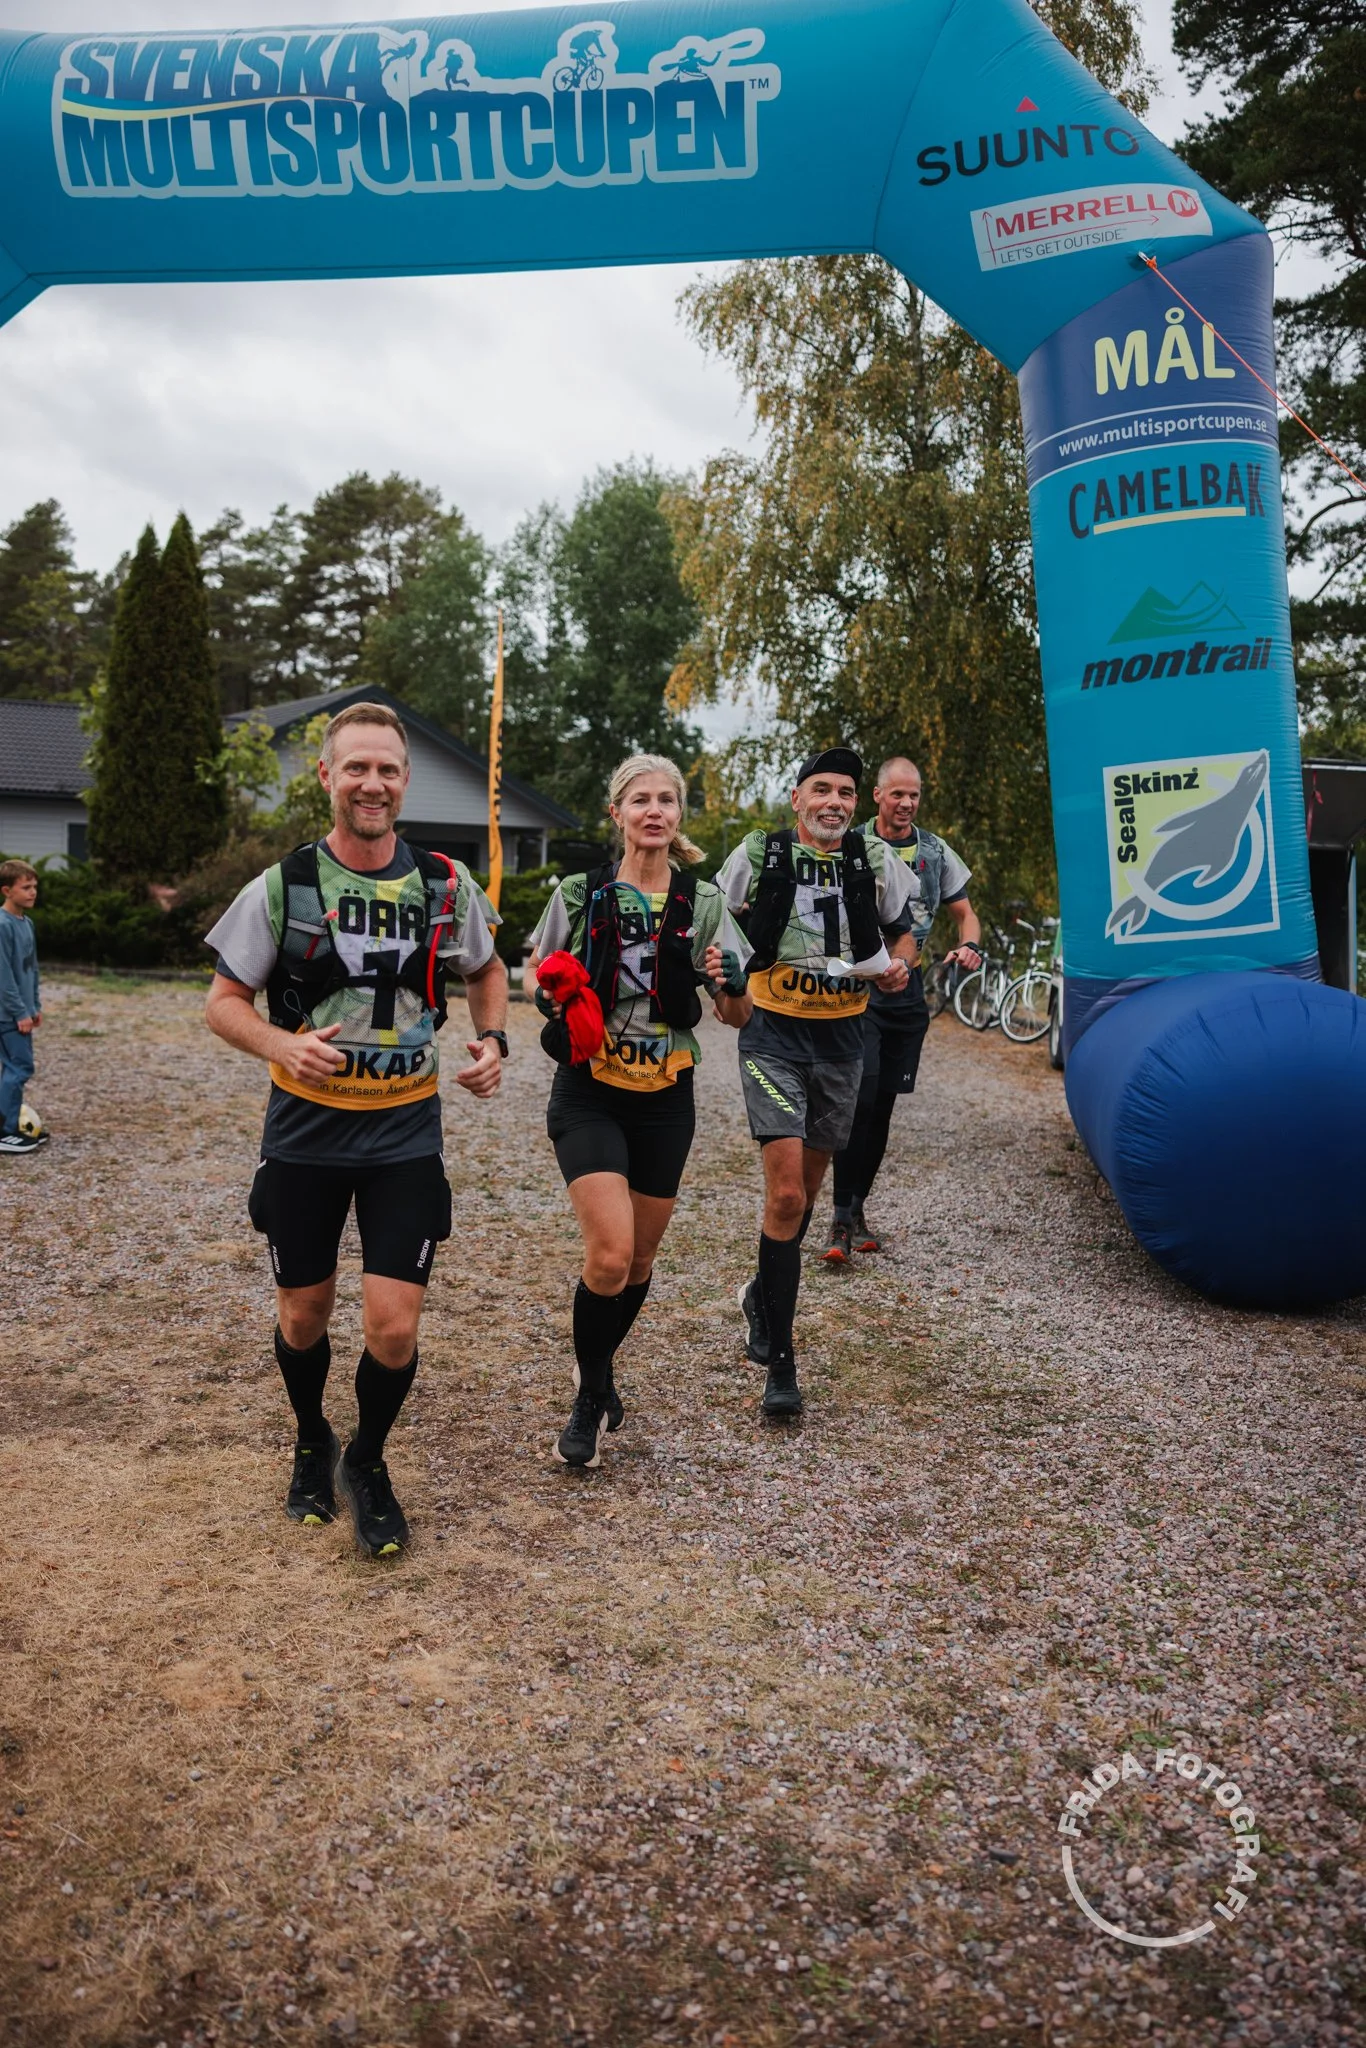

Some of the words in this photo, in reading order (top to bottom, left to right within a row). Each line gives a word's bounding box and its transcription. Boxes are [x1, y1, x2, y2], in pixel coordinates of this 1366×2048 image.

[63, 32, 386, 102] SVENSKA
[62, 79, 747, 188] MULTISPORTCUPEN
[916, 124, 1140, 187] SUUNTO
[995, 193, 1167, 238] MERRELL
[1001, 247, 1034, 264] LET'S
[1035, 240, 1062, 258] GET
[1064, 228, 1124, 250] OUTSIDE
[1094, 306, 1236, 395] MÅL
[1058, 414, 1267, 457] www.multisportcupen.se
[1068, 461, 1266, 540] CAMELBAK
[1080, 637, 1273, 691] montrail
[1114, 796, 1139, 864] Seal
[332, 1083, 383, 1097] Karlsson
[745, 1060, 796, 1114] DYNAFIT
[416, 1238, 431, 1269] FUSION
